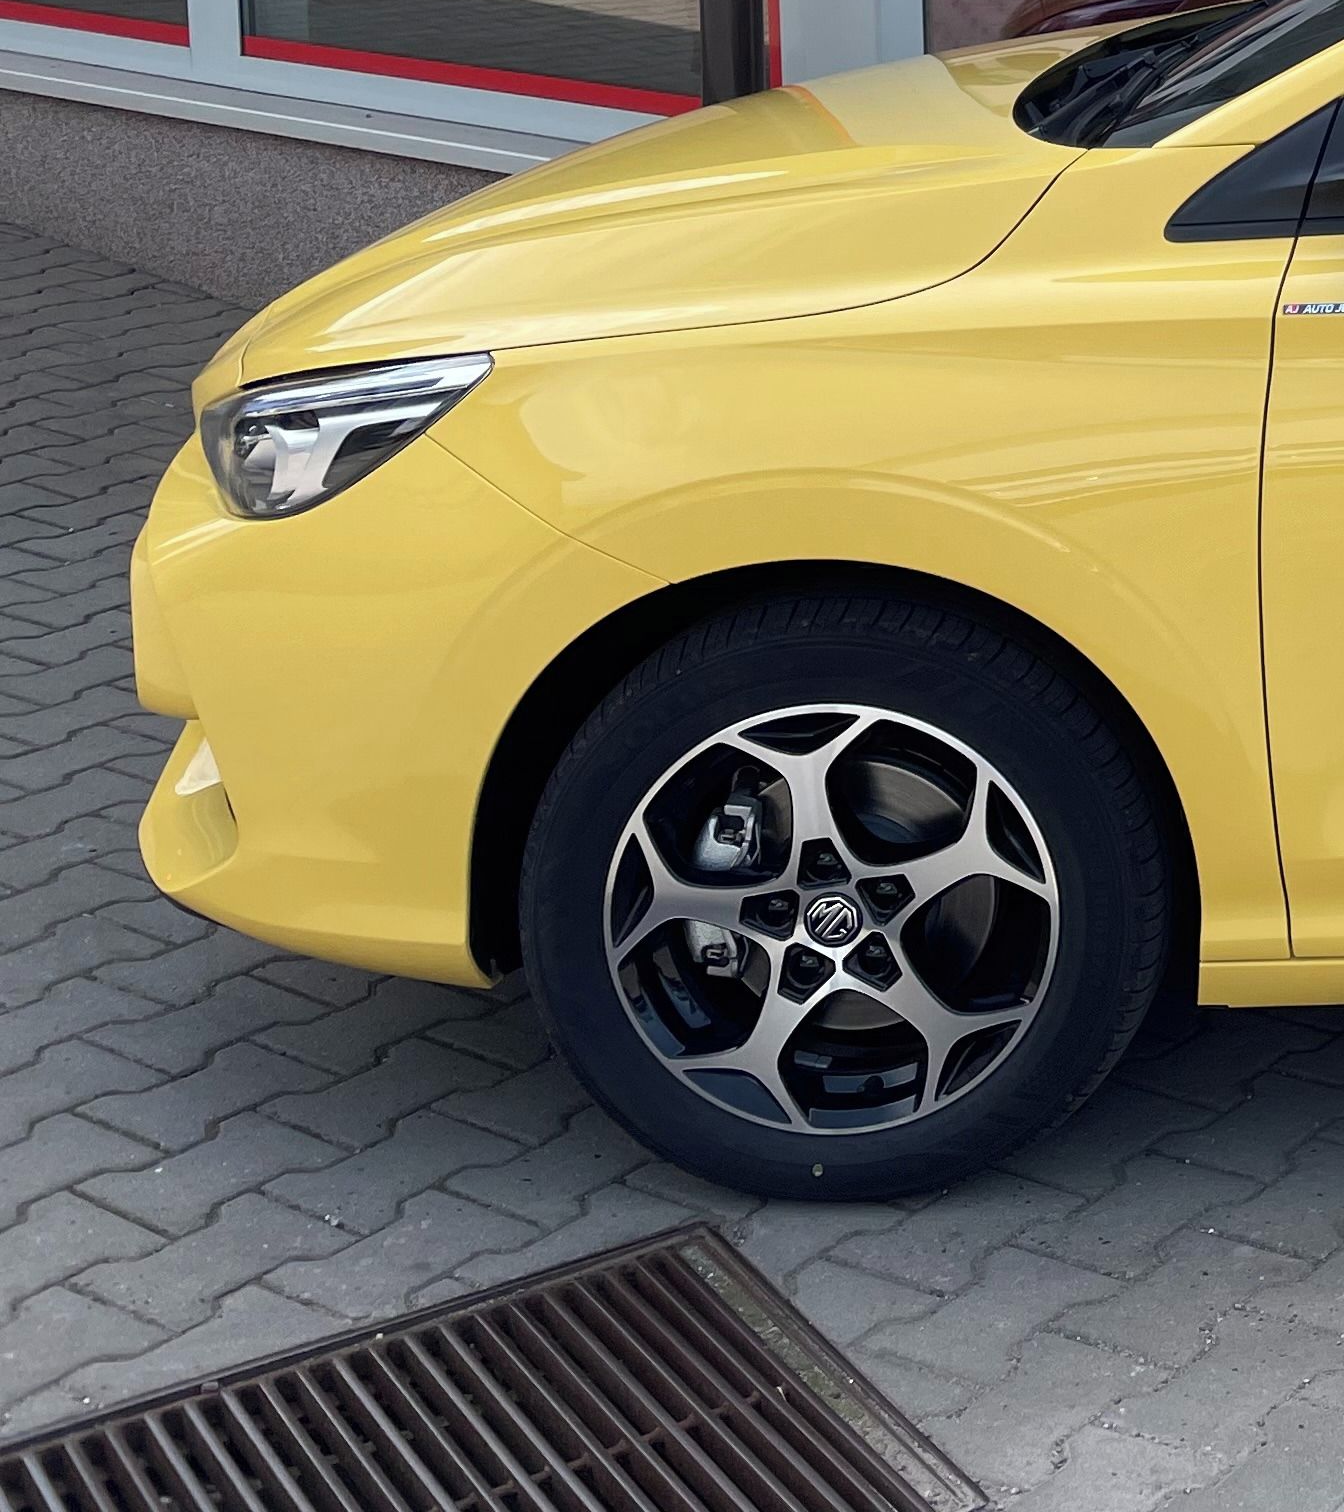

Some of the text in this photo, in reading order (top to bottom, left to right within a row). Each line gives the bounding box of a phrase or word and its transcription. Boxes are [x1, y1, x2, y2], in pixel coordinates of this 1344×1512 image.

[1285, 305, 1300, 314] AJ
[1303, 303, 1335, 314] AUTO
[810, 901, 855, 941] MG
